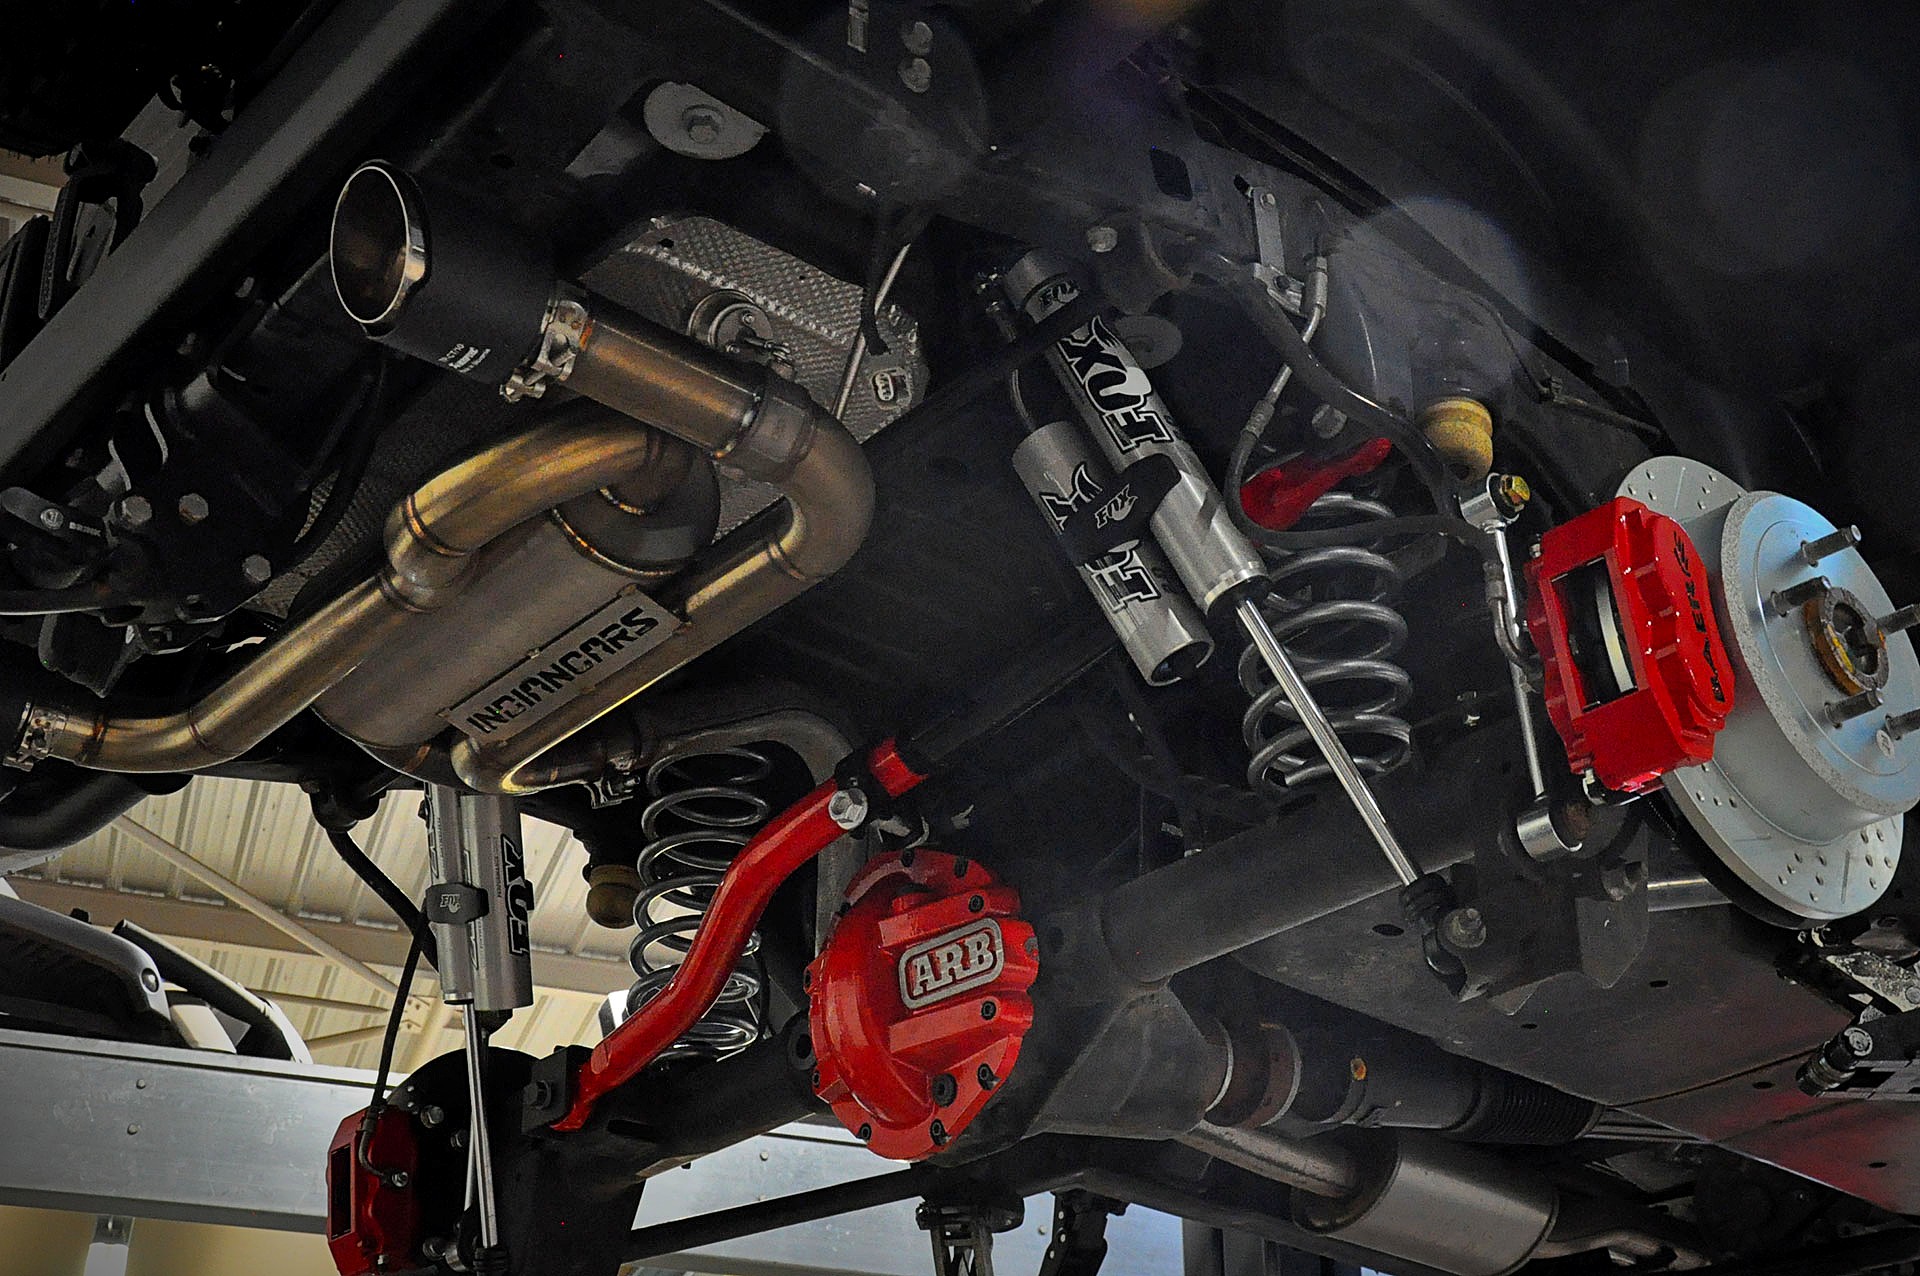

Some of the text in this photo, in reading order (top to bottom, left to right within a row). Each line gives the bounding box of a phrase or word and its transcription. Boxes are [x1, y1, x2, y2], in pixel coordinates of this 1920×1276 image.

[1057, 315, 1174, 454] FOX
[1095, 484, 1138, 529] FOX
[466, 606, 658, 734] INDIANCARS
[440, 893, 461, 914] FOX
[502, 834, 531, 956] FOX
[912, 932, 995, 998] ARB
